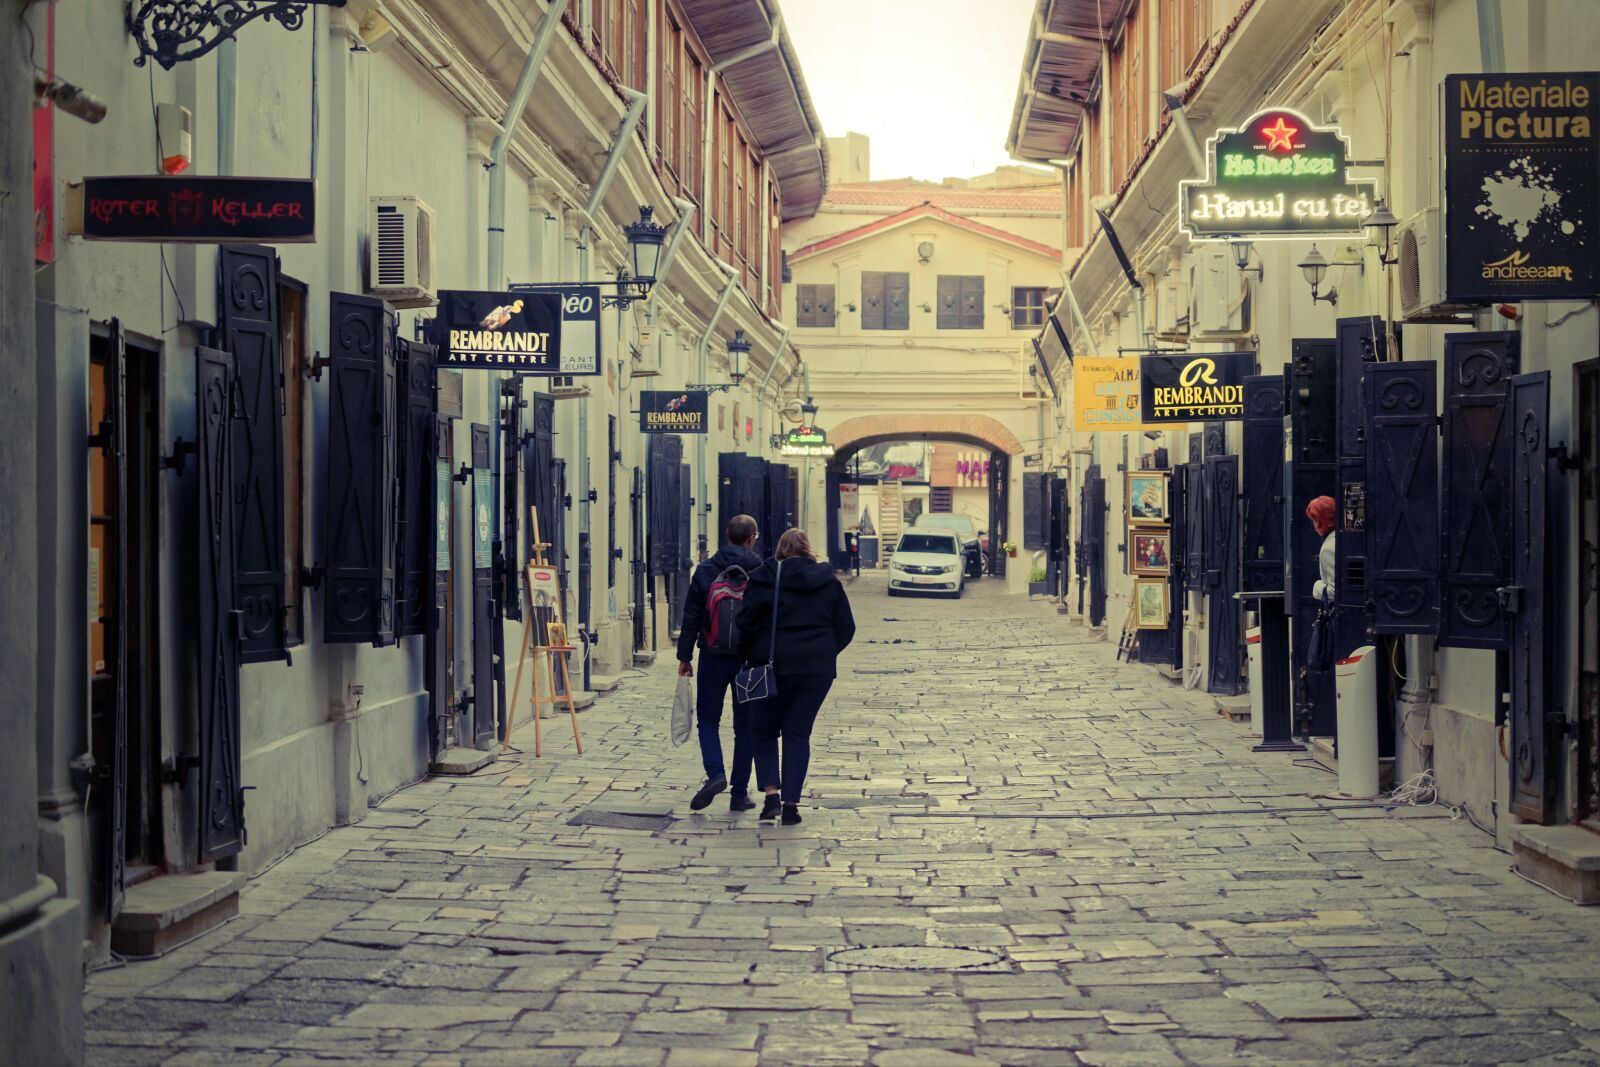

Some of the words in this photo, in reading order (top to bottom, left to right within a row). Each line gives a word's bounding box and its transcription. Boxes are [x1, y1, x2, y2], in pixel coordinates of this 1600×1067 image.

[1460, 79, 1590, 109] Materiale
[1460, 110, 1591, 139] Pictura
[1224, 154, 1337, 176] Heineken
[89, 198, 161, 224] ROTER
[212, 197, 305, 226] KELLER
[1192, 193, 1284, 218] Hanul
[1292, 199, 1329, 217] cu
[1331, 192, 1371, 217] tei
[1482, 261, 1573, 281] andreeaart
[450, 329, 550, 352] REMBRANDT
[448, 353, 478, 362] ART
[485, 354, 547, 364] CENTRE
[1154, 385, 1244, 406] REMBRANDT
[647, 411, 702, 423] REMBRANDT
[1154, 409, 1179, 417] ART
